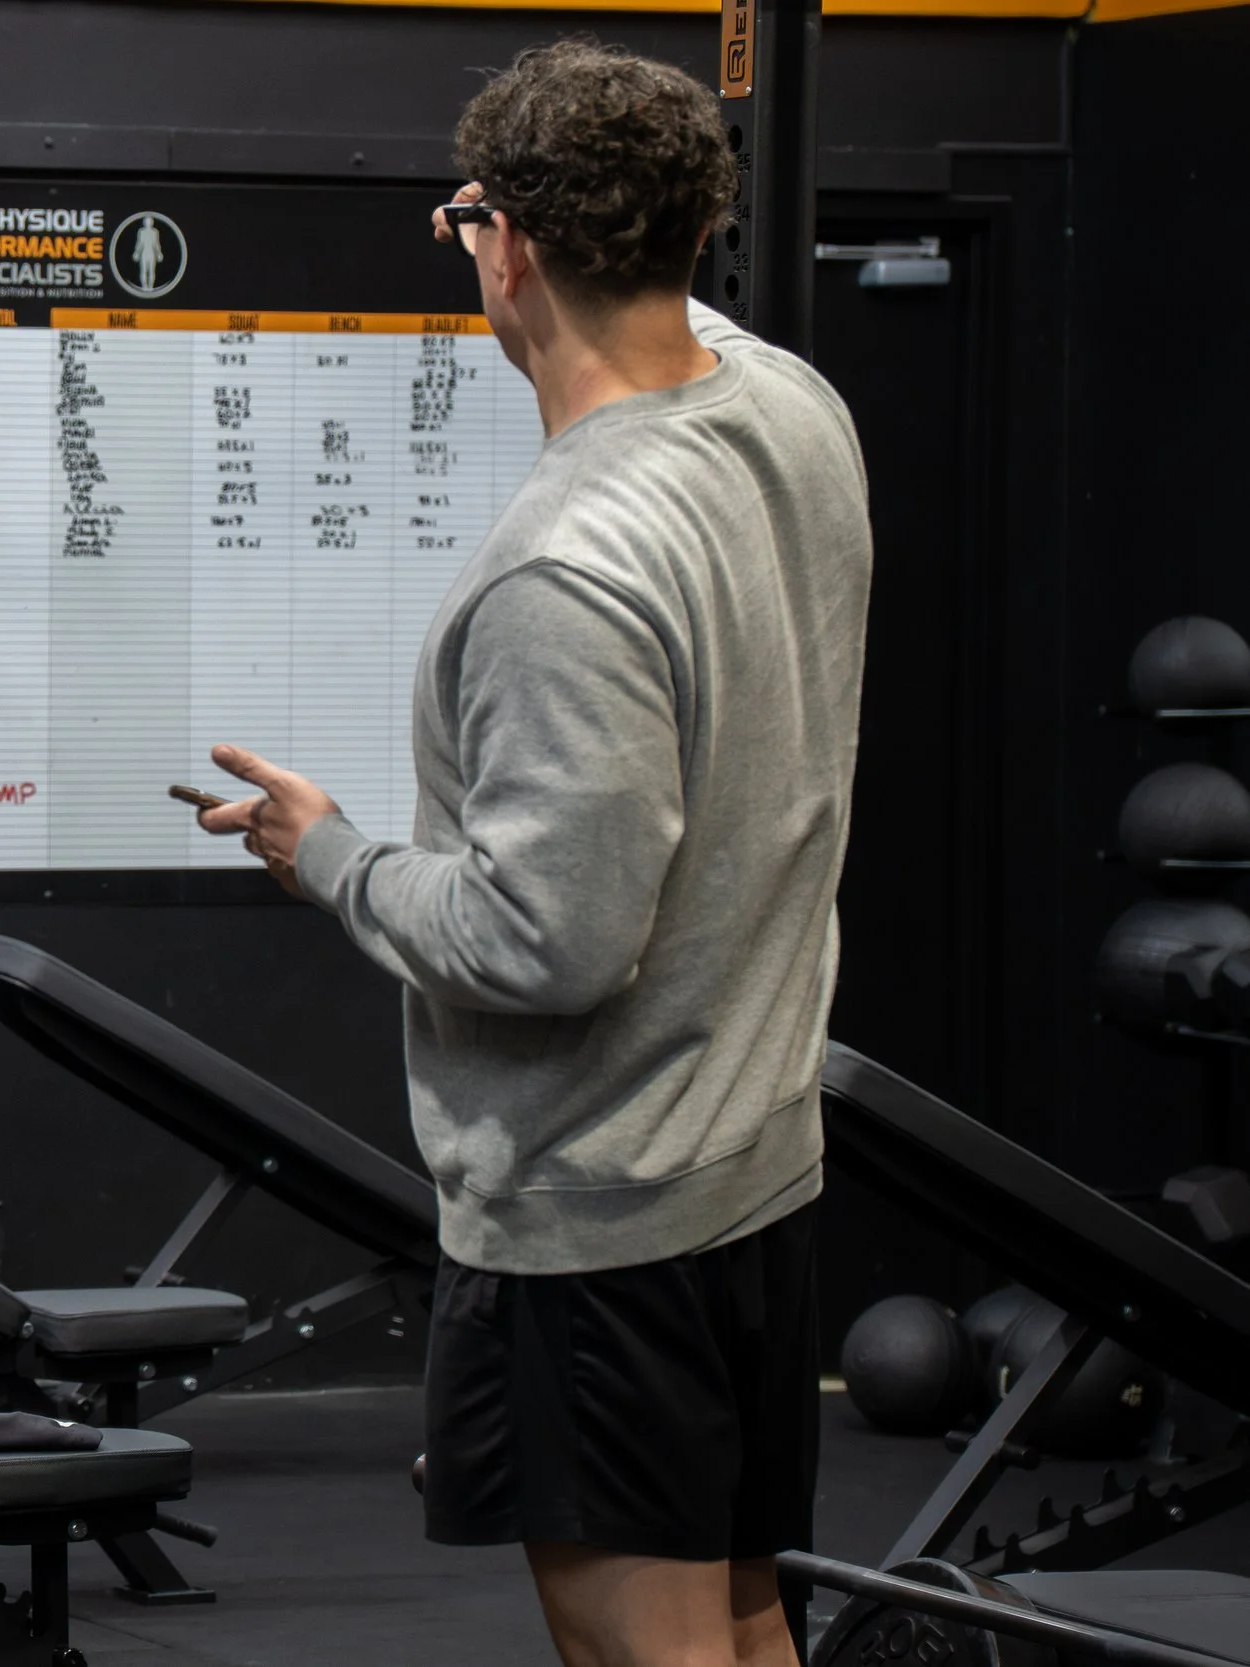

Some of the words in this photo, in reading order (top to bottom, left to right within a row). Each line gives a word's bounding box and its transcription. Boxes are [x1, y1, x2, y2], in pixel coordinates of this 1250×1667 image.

[47, 287, 104, 299] NUTRITION
[108, 312, 137, 329] NAME
[228, 313, 260, 331] SQUAT
[328, 315, 362, 332] BENCH
